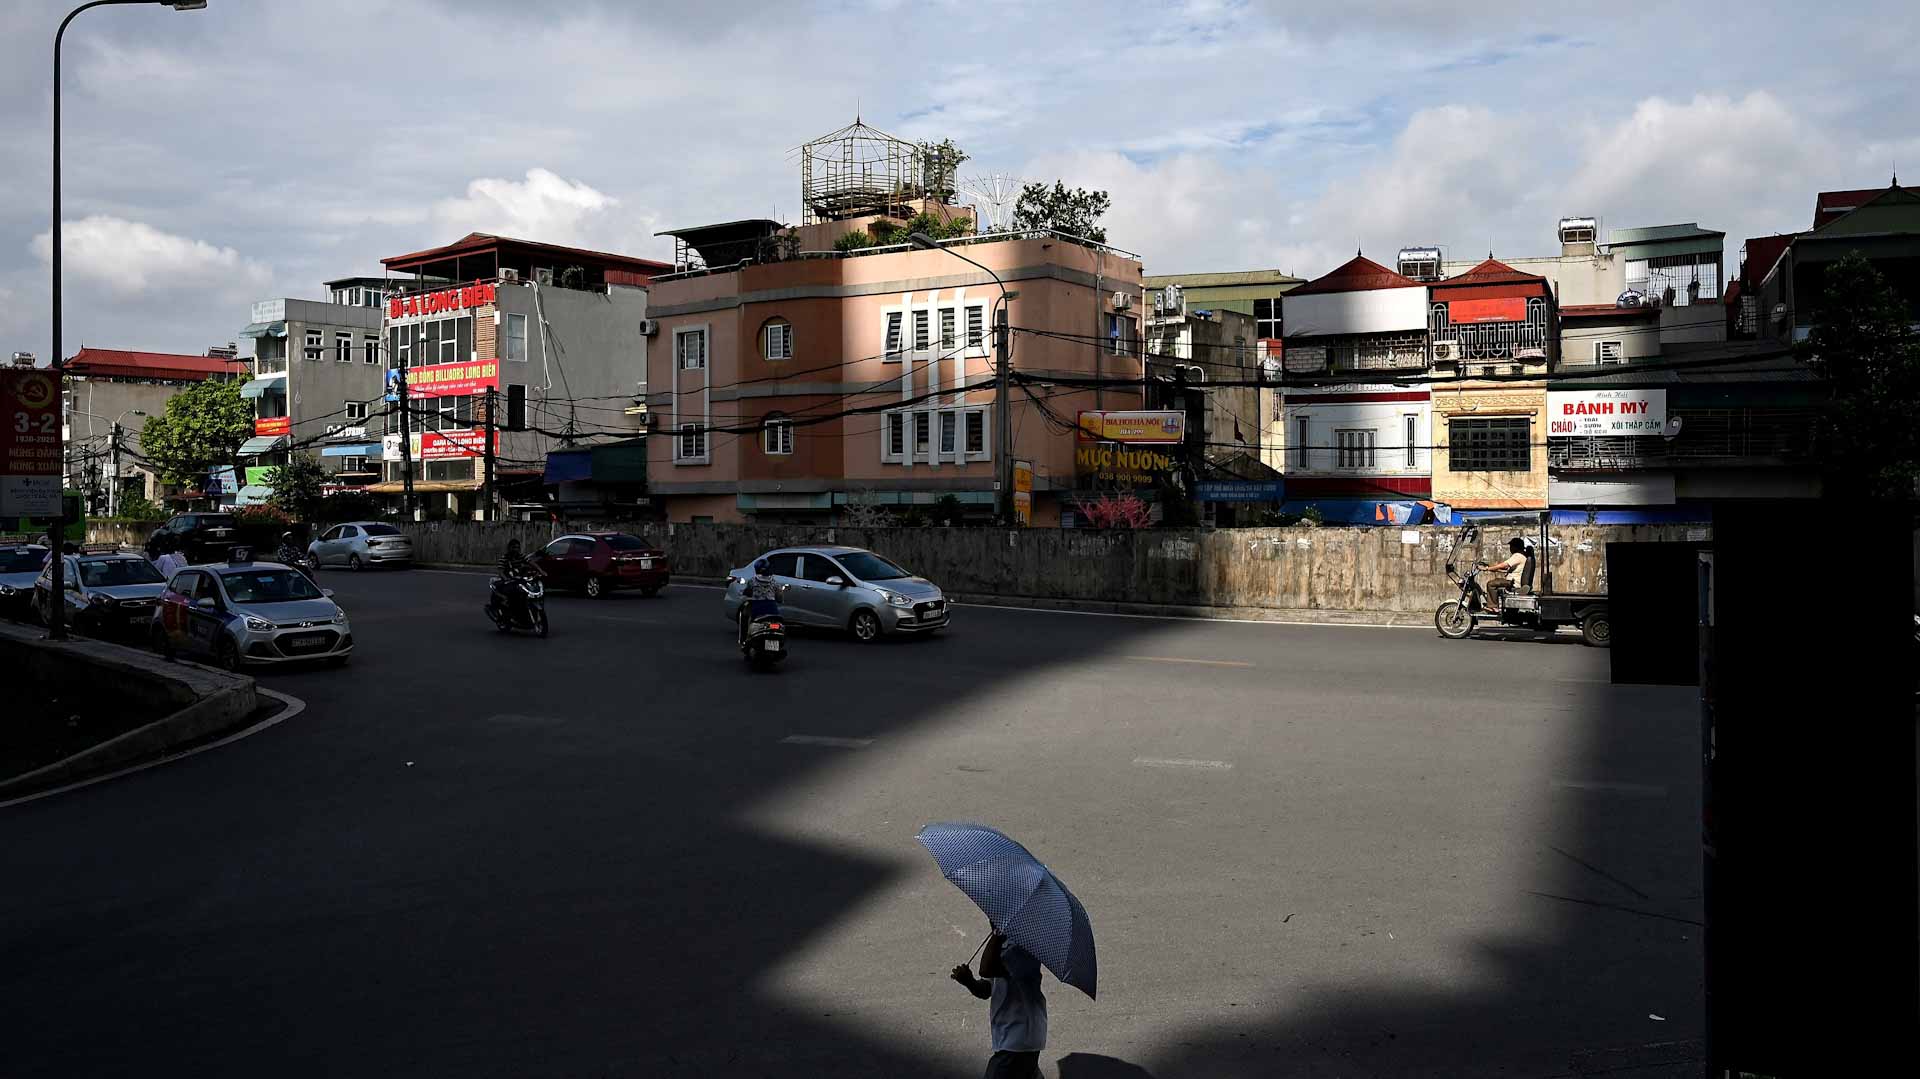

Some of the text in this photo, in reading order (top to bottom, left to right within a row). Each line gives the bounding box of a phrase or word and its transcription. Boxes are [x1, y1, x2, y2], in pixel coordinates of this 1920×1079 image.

[420, 289, 459, 315] LONG
[462, 279, 495, 308] BIÊN
[1563, 400, 1613, 415] BÁNH
[14, 411, 56, 433] 3-2
[1099, 472, 1114, 480] 038
